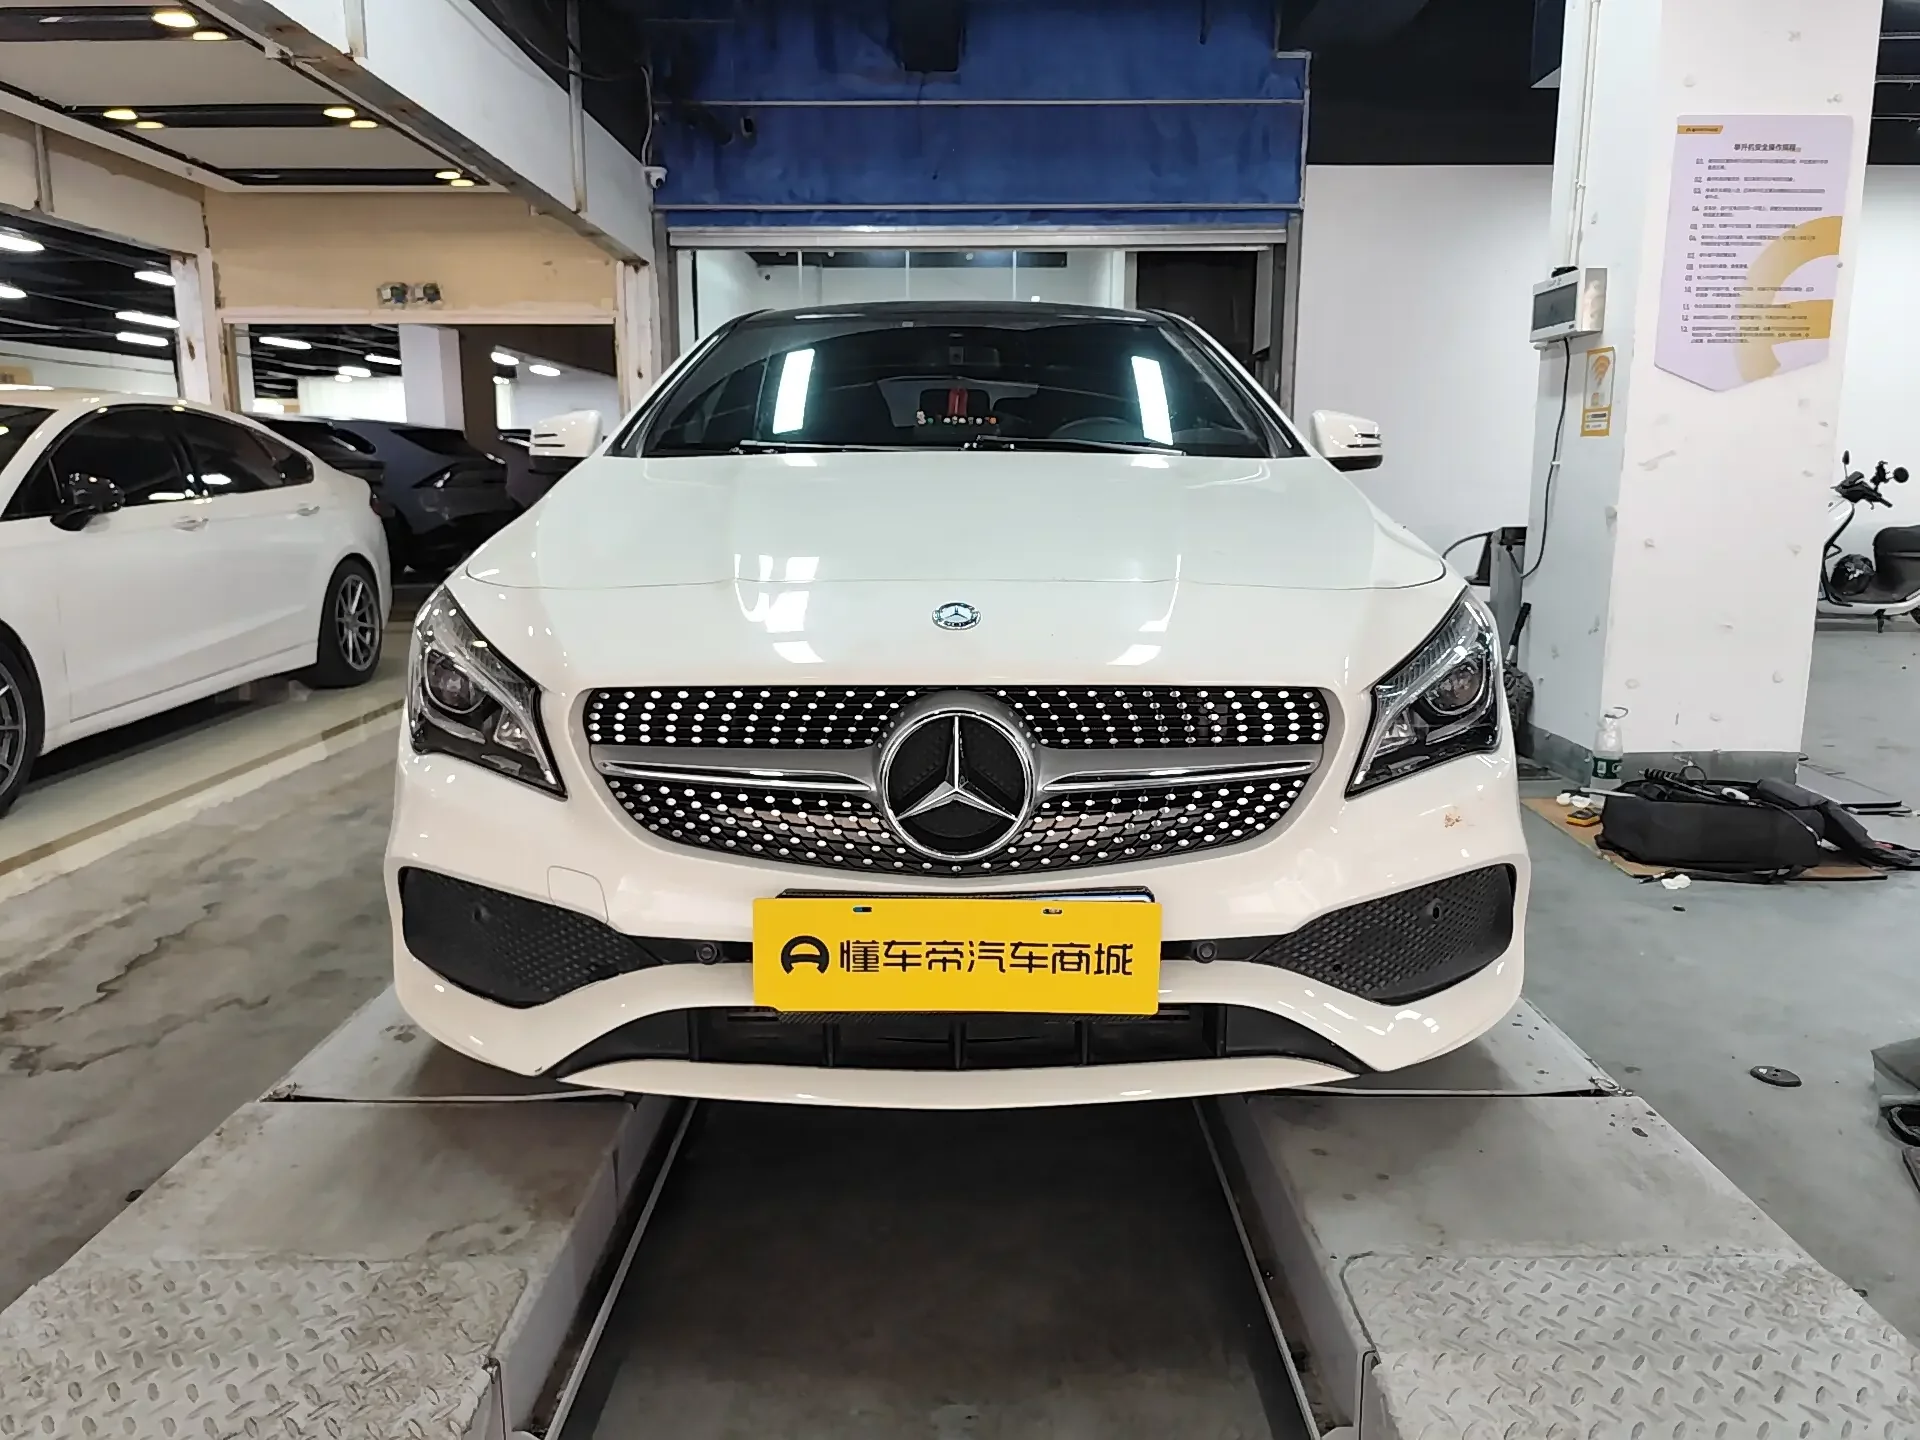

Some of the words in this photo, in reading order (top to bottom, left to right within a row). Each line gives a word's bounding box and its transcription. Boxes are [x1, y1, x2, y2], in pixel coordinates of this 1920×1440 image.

[839, 939, 1133, 976] 懂车帝汽车商城
